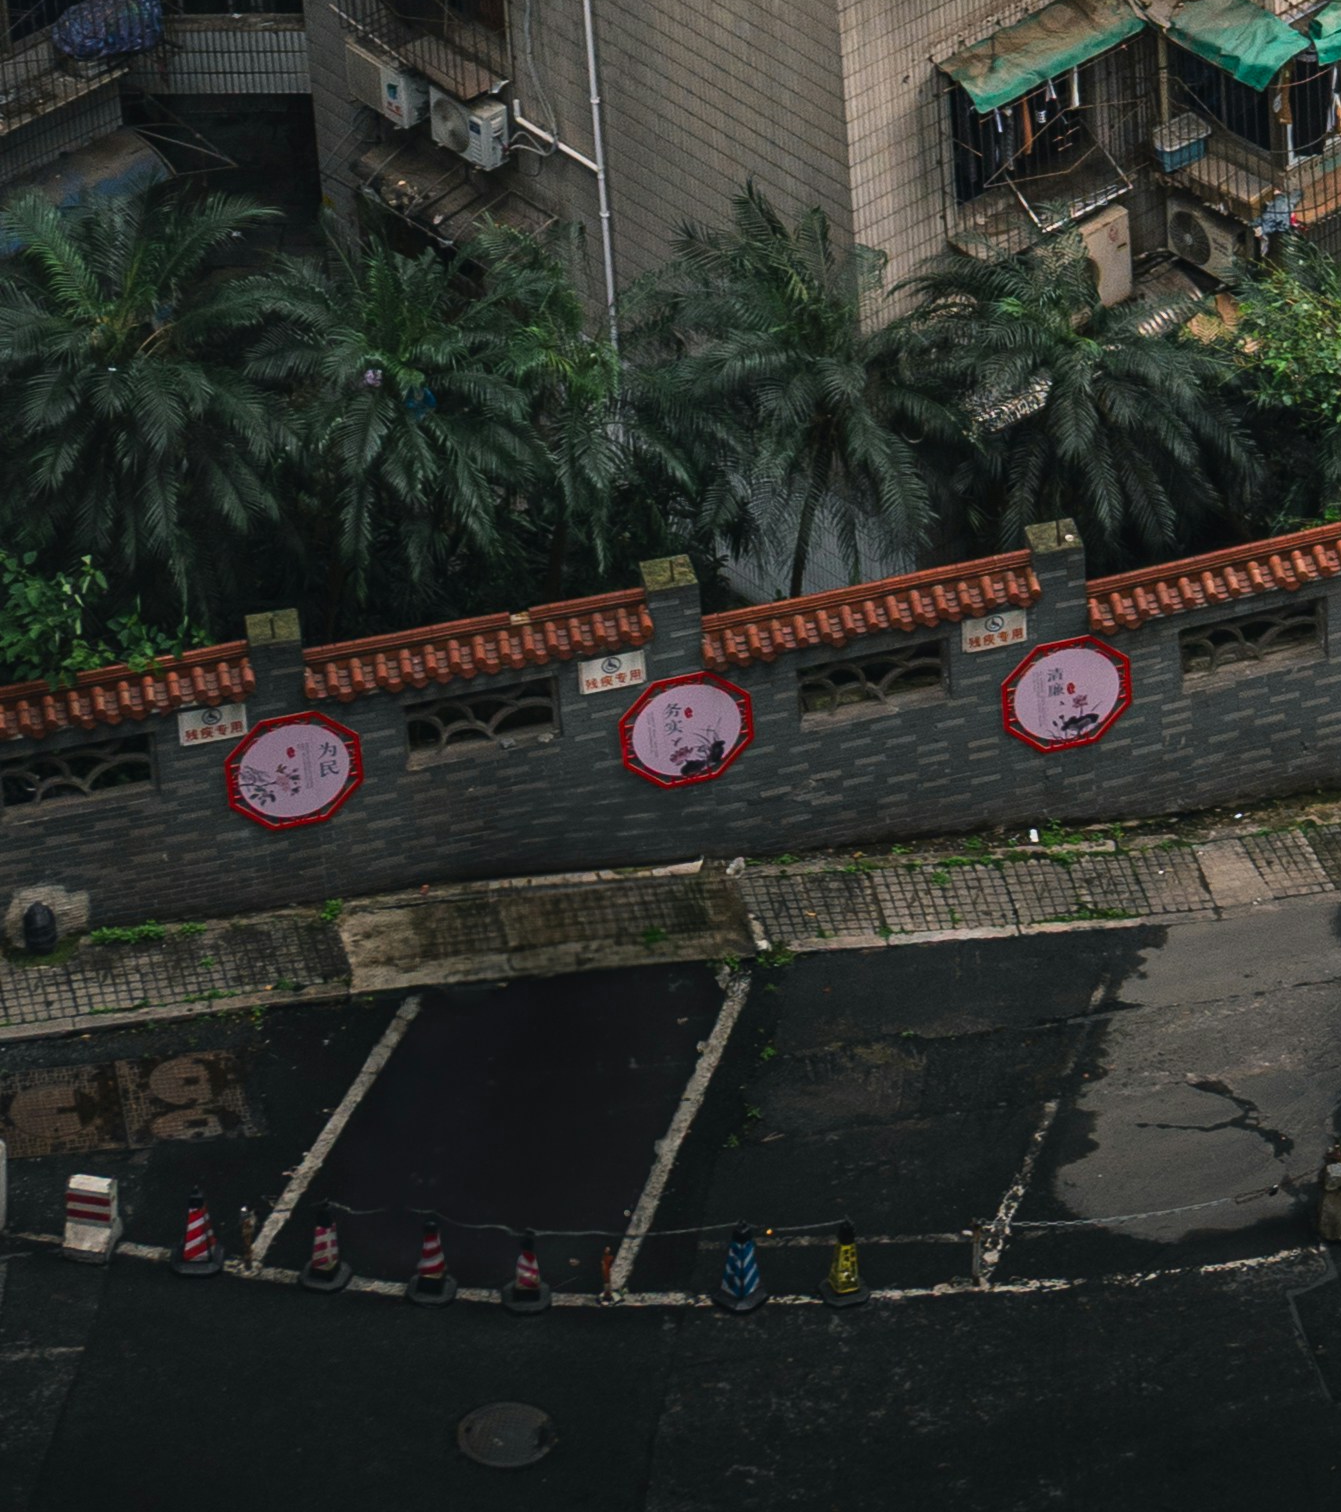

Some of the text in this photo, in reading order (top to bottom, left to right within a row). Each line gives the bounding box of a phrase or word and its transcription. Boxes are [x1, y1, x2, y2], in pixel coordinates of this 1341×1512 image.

[968, 628, 1024, 648] 残疾专用
[585, 669, 642, 690] 残疾专用
[664, 703, 684, 736] 务实
[185, 721, 244, 741] 残疾专用
[318, 742, 340, 778] 为民
